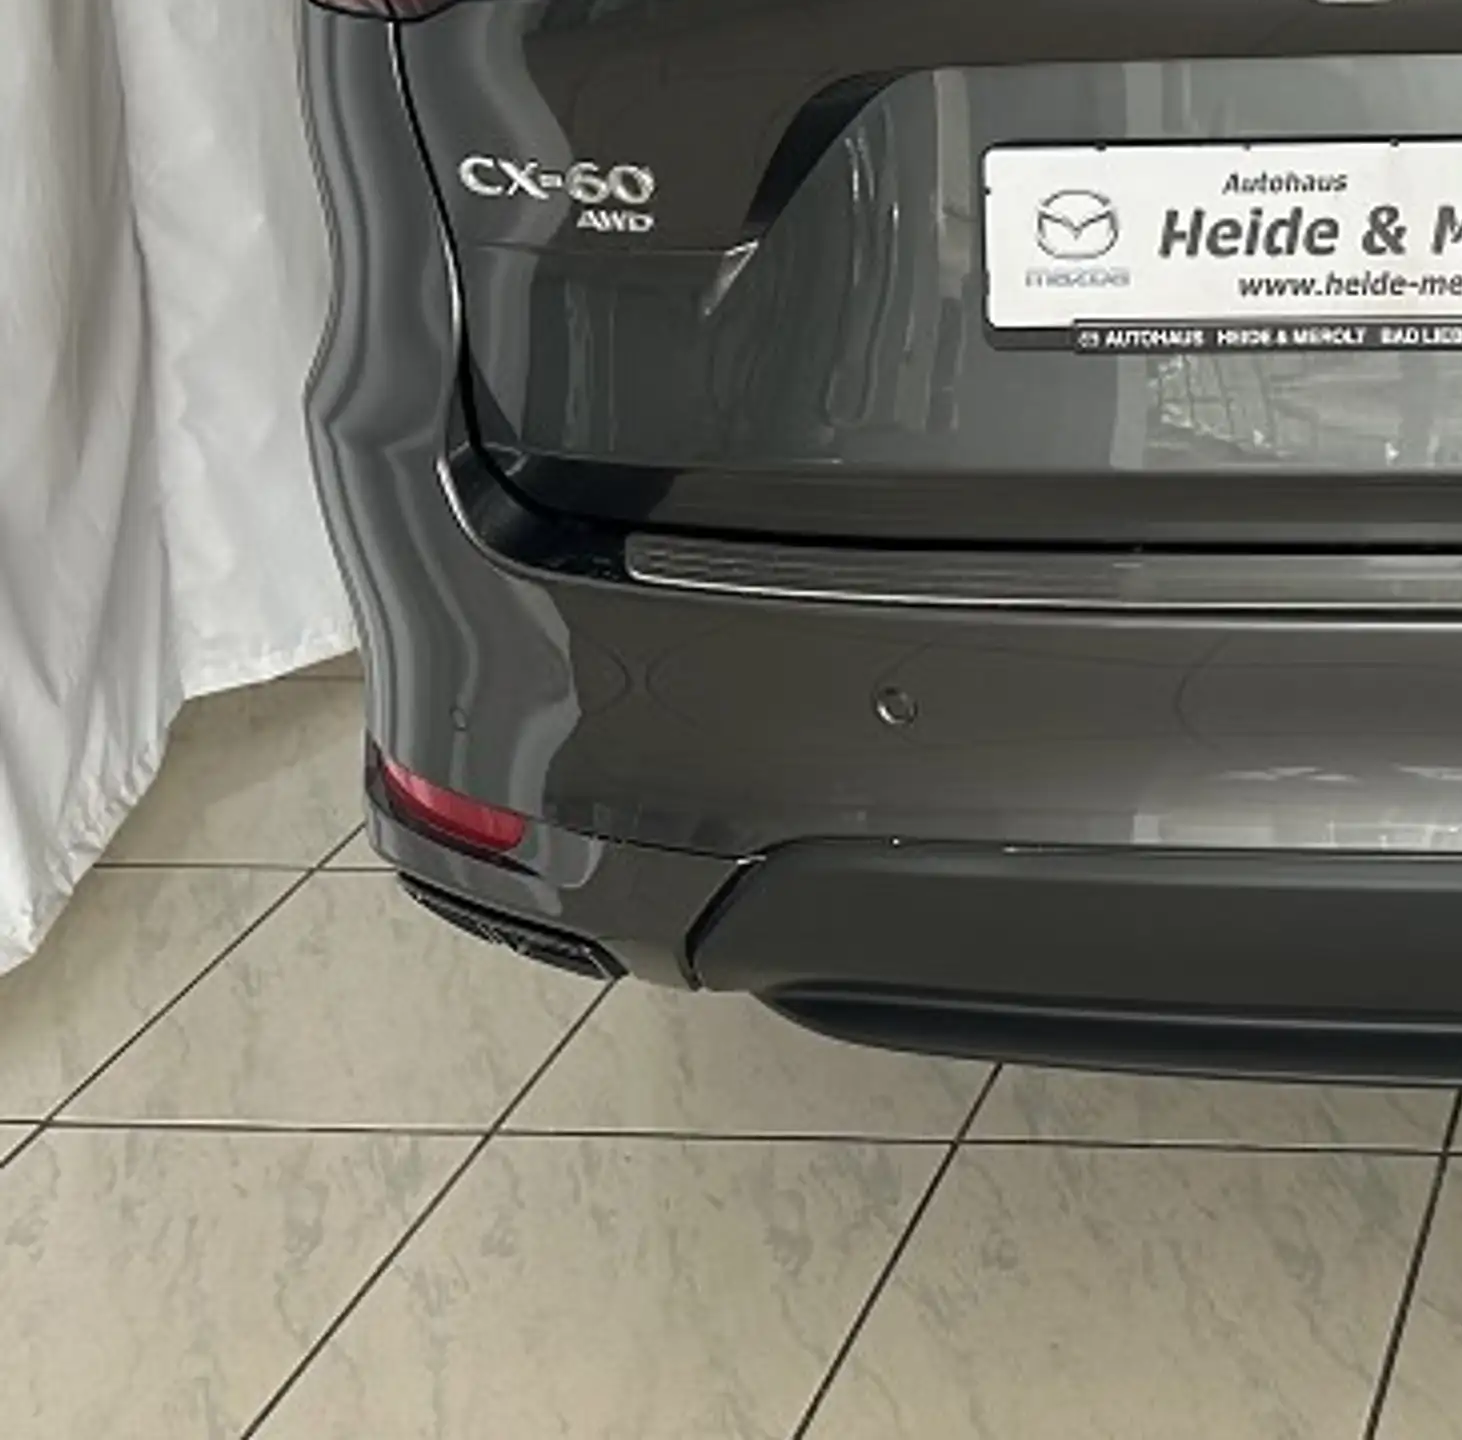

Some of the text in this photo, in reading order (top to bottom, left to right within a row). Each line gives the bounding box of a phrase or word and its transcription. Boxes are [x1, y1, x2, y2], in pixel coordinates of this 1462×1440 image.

[458, 157, 655, 205] CX-60
[1221, 171, 1349, 195] Autohaus
[577, 211, 655, 232] AWD
[1158, 206, 1340, 258] Heide
[1361, 204, 1407, 256] &
[1025, 266, 1131, 288] mazda
[1105, 327, 1205, 347] AUTOHAUS
[1293, 325, 1367, 345] MEROLT
